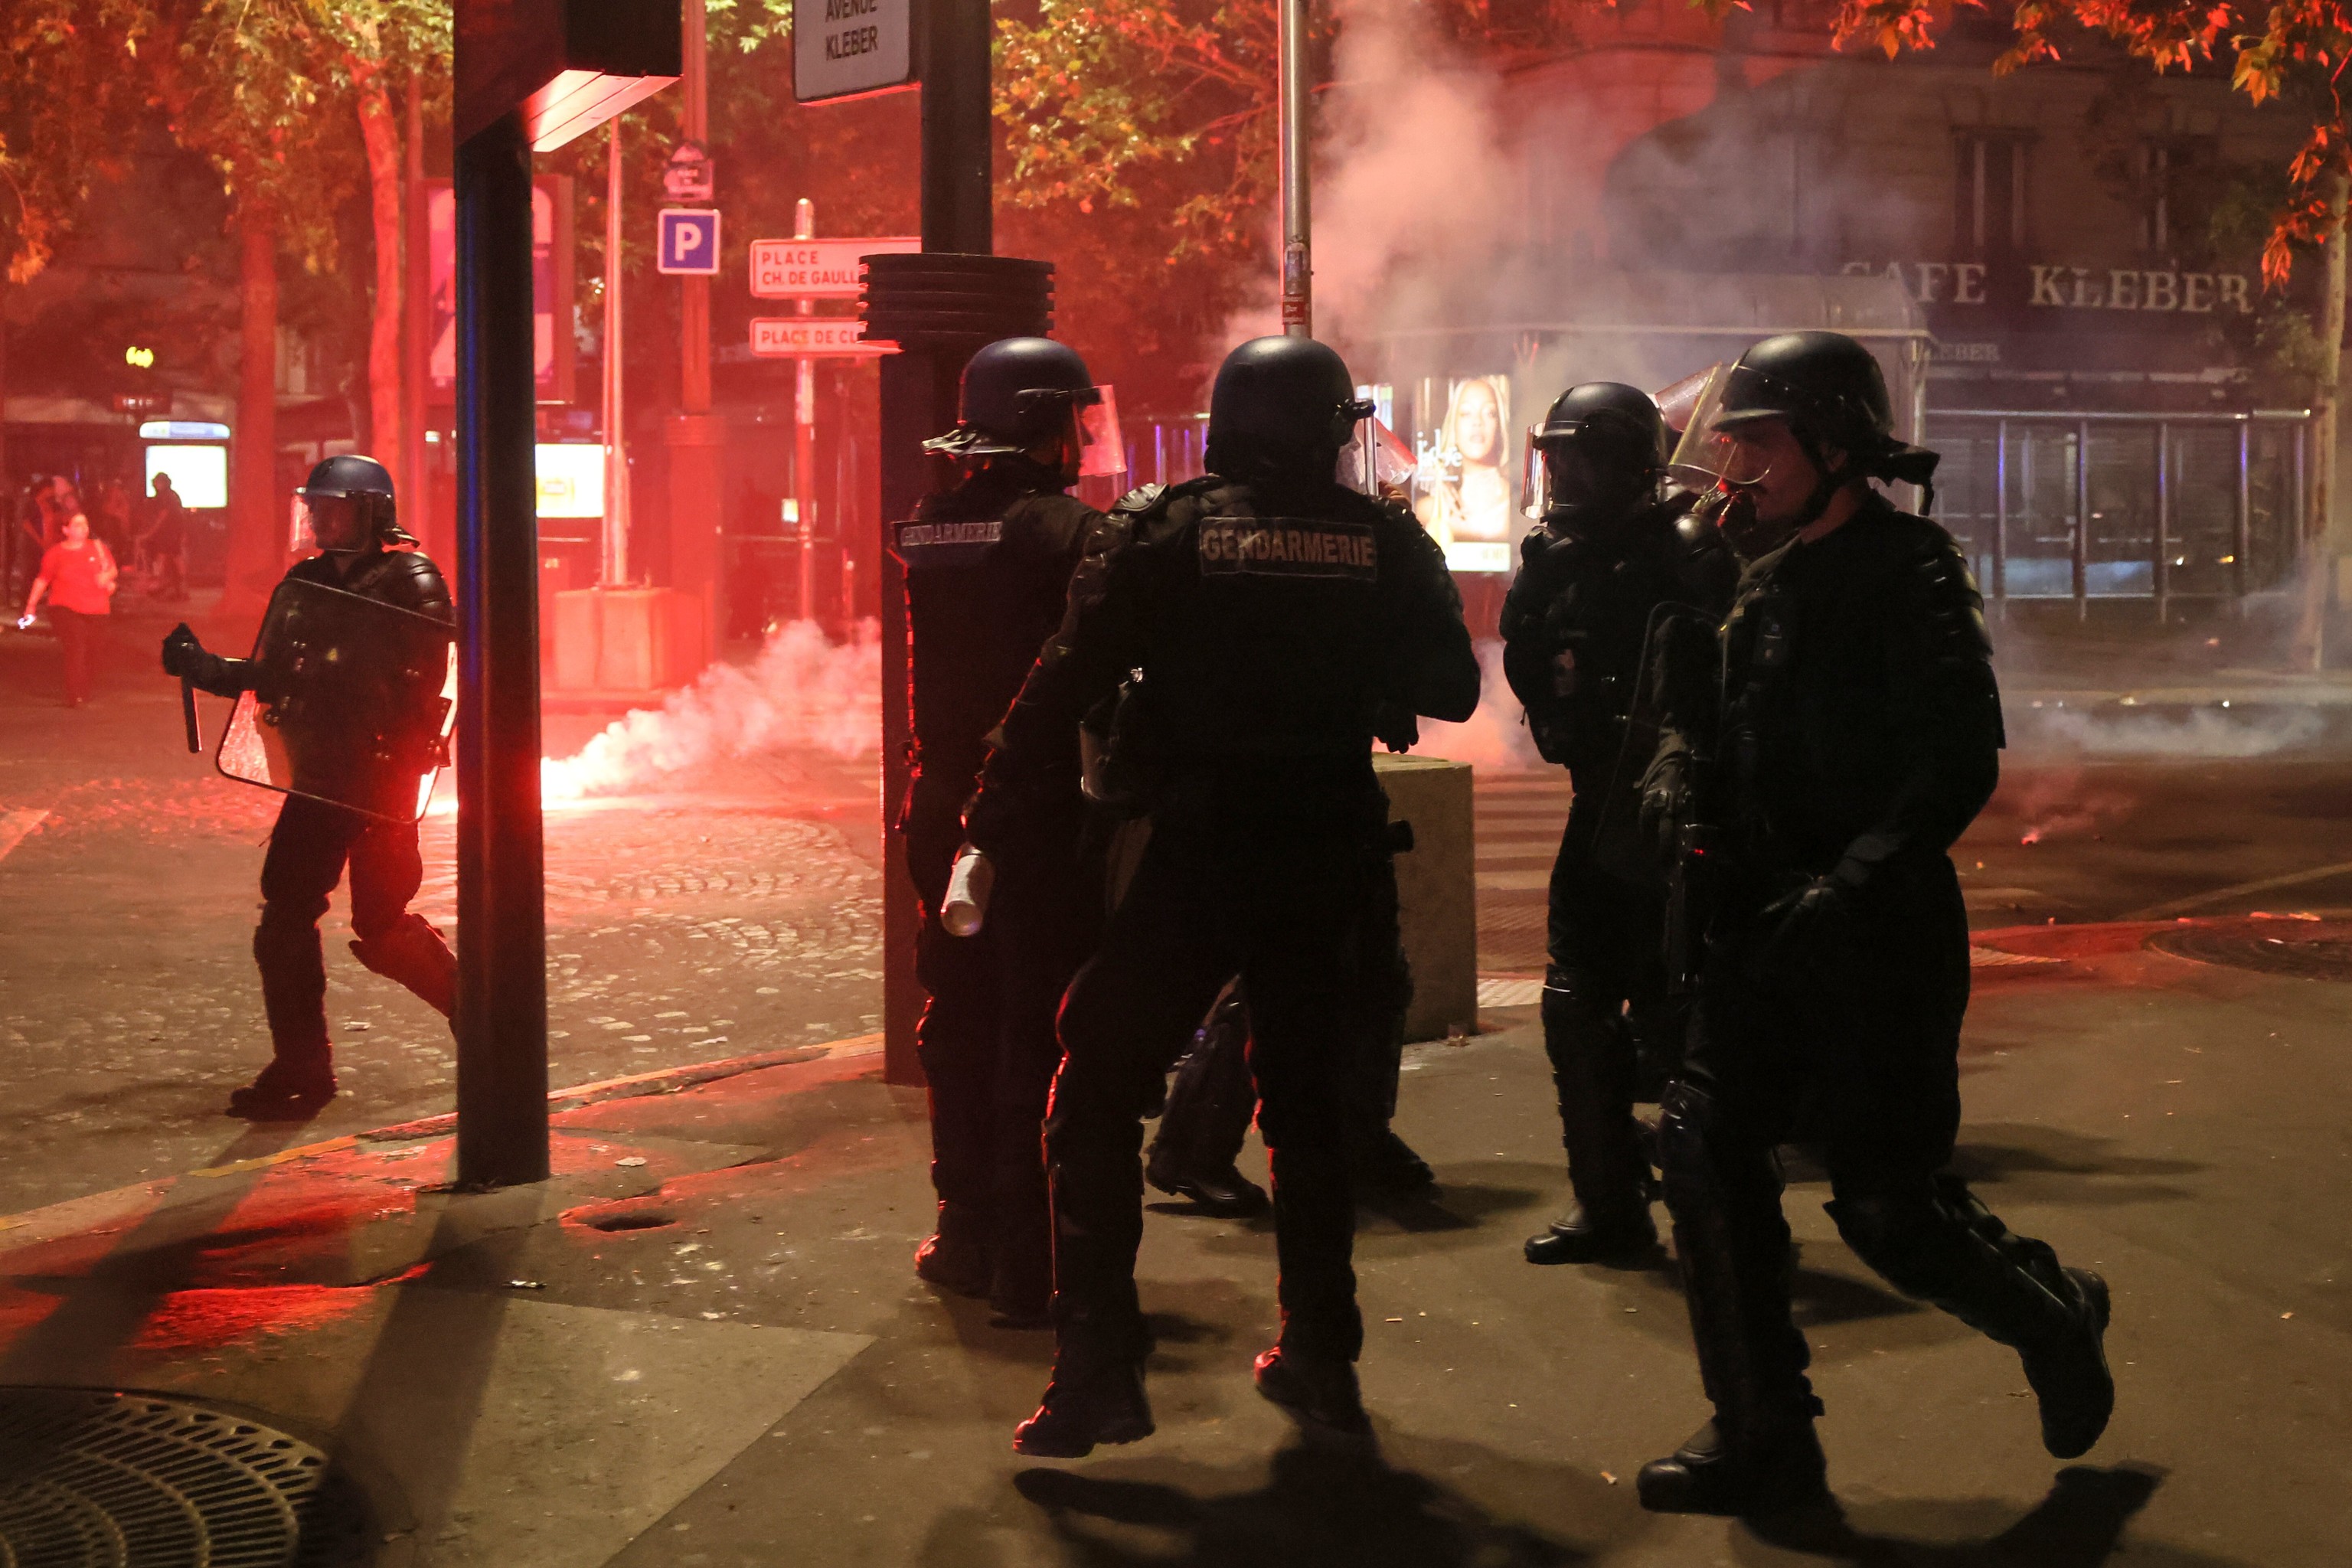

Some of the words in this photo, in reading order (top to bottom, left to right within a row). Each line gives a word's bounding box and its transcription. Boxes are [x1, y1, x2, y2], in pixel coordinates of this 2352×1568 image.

[826, 25, 879, 61] KLEBER
[675, 222, 702, 261] P
[762, 250, 818, 265] PLACE
[789, 271, 806, 285] DE
[811, 270, 858, 284] GAULL
[2029, 265, 2256, 312] KLEBER
[762, 330, 808, 344] PLACE
[815, 330, 834, 343] DE
[838, 329, 858, 343] CL
[1203, 528, 1375, 567] GENDARMERIE
